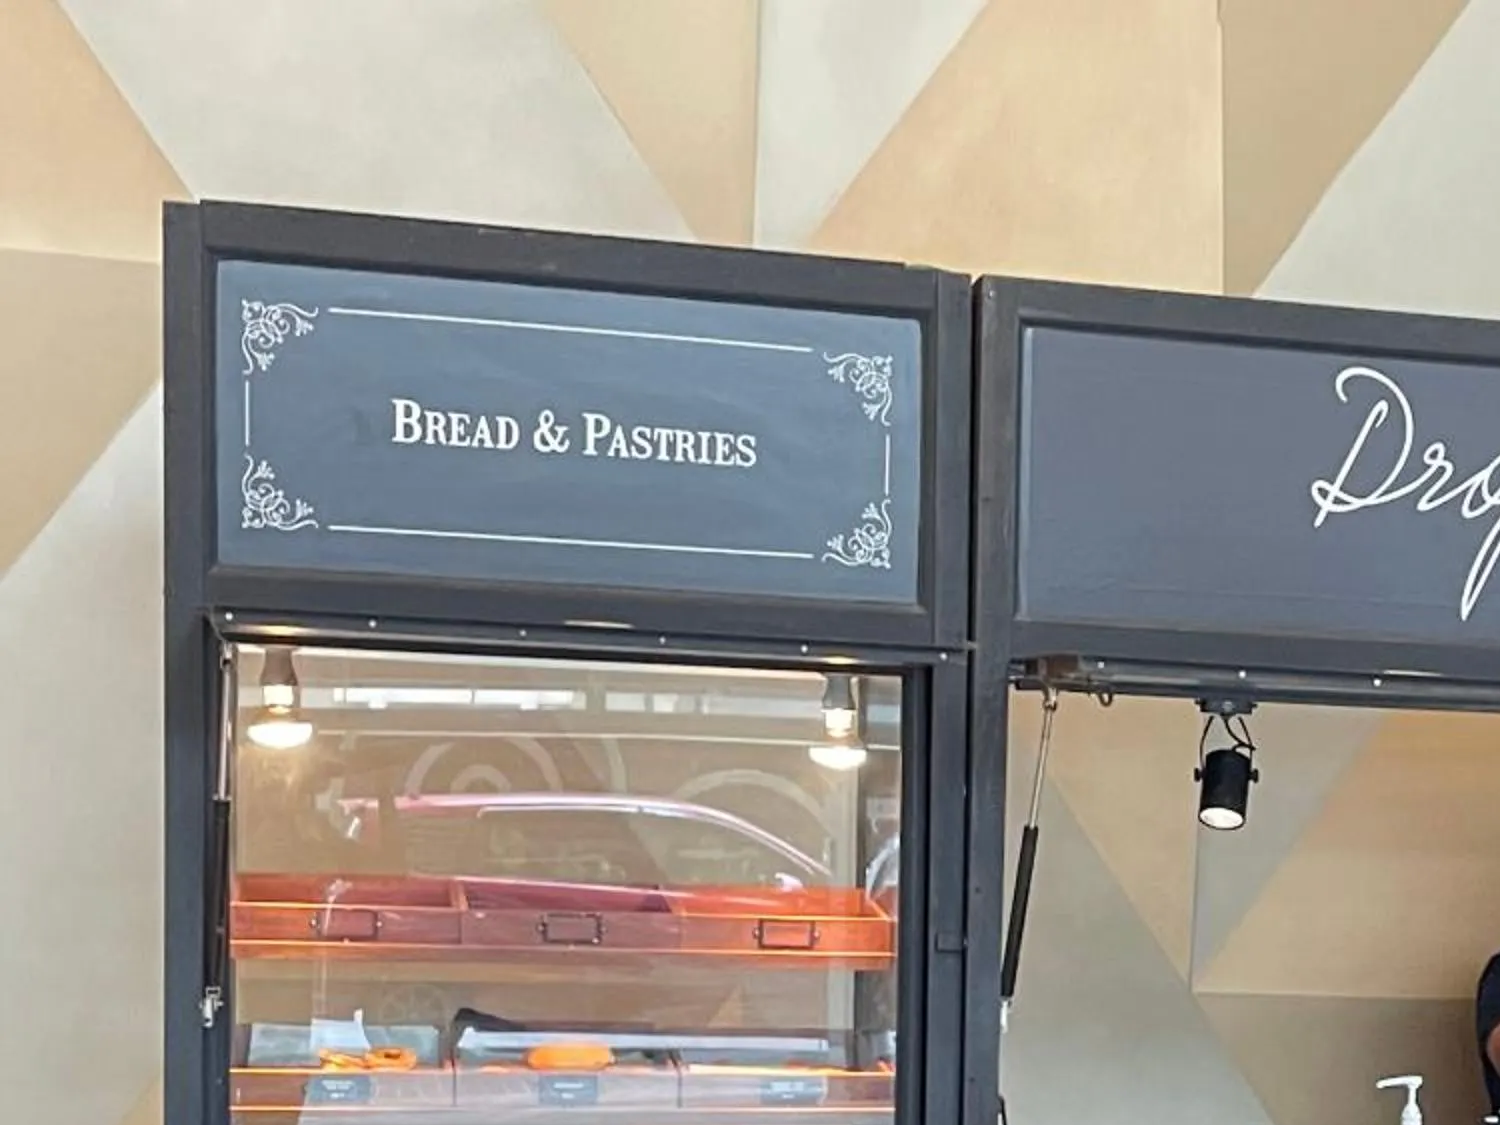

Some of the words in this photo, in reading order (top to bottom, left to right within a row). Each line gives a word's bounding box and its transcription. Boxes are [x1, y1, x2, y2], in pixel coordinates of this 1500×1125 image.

[391, 398, 519, 451] BREAD
[533, 409, 570, 455] &
[583, 413, 757, 468] PASTRIES
